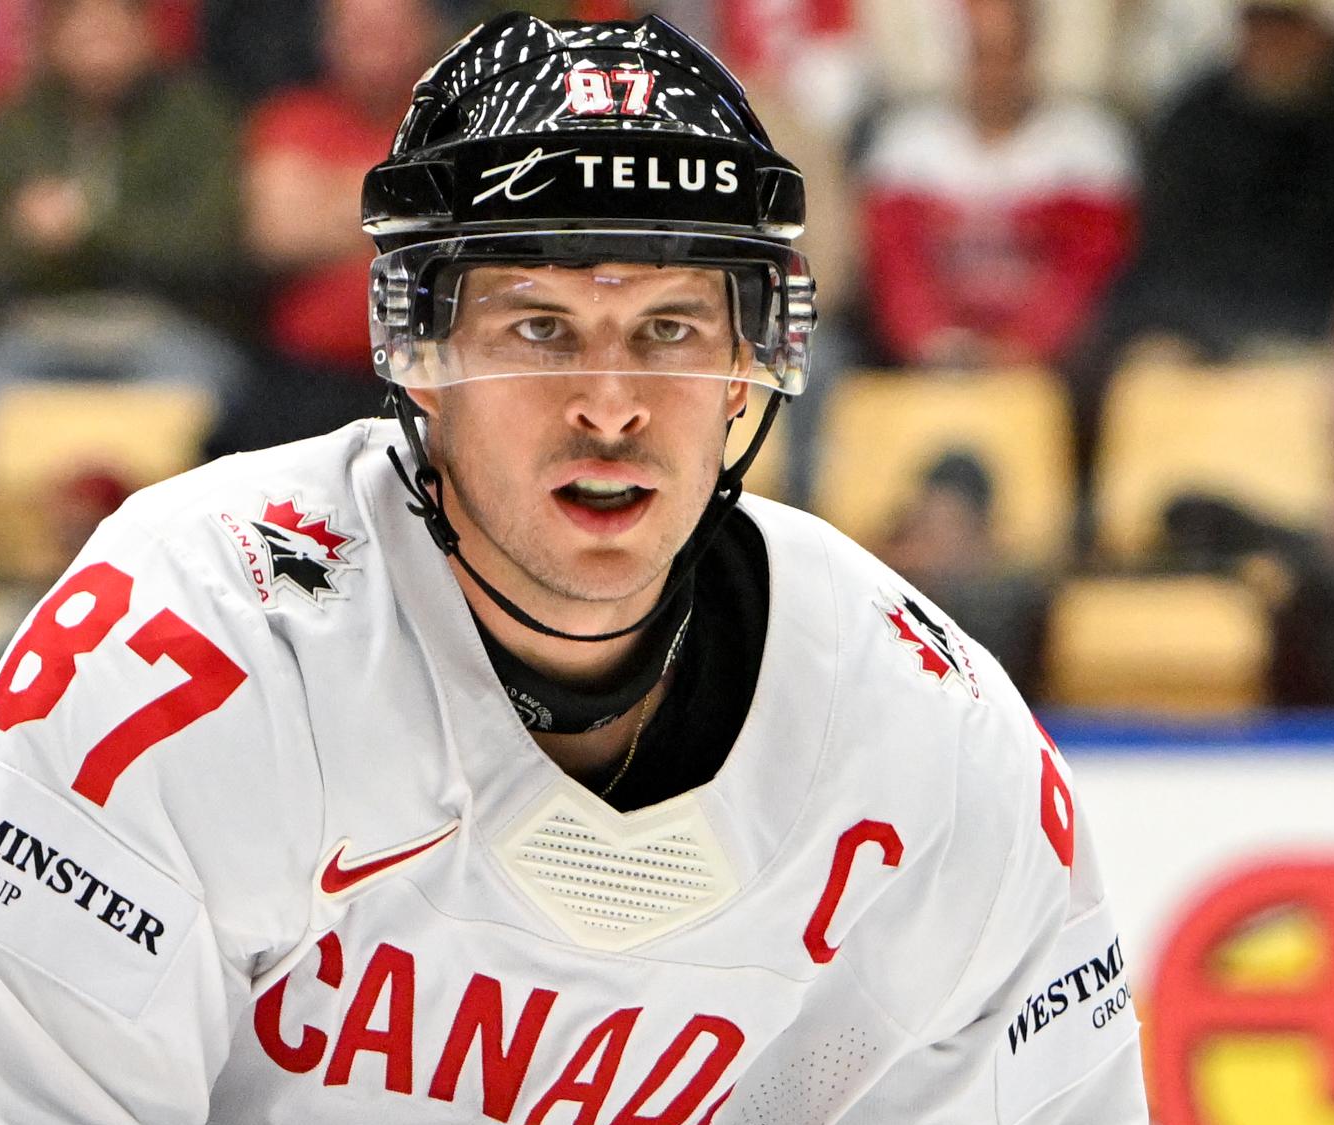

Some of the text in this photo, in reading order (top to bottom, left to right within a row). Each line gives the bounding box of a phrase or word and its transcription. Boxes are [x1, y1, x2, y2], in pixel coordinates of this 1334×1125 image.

[563, 70, 656, 115] 87
[574, 155, 739, 194] TELUS
[220, 512, 270, 603] CANADA
[944, 622, 980, 700] CANA
[802, 819, 904, 964] C
